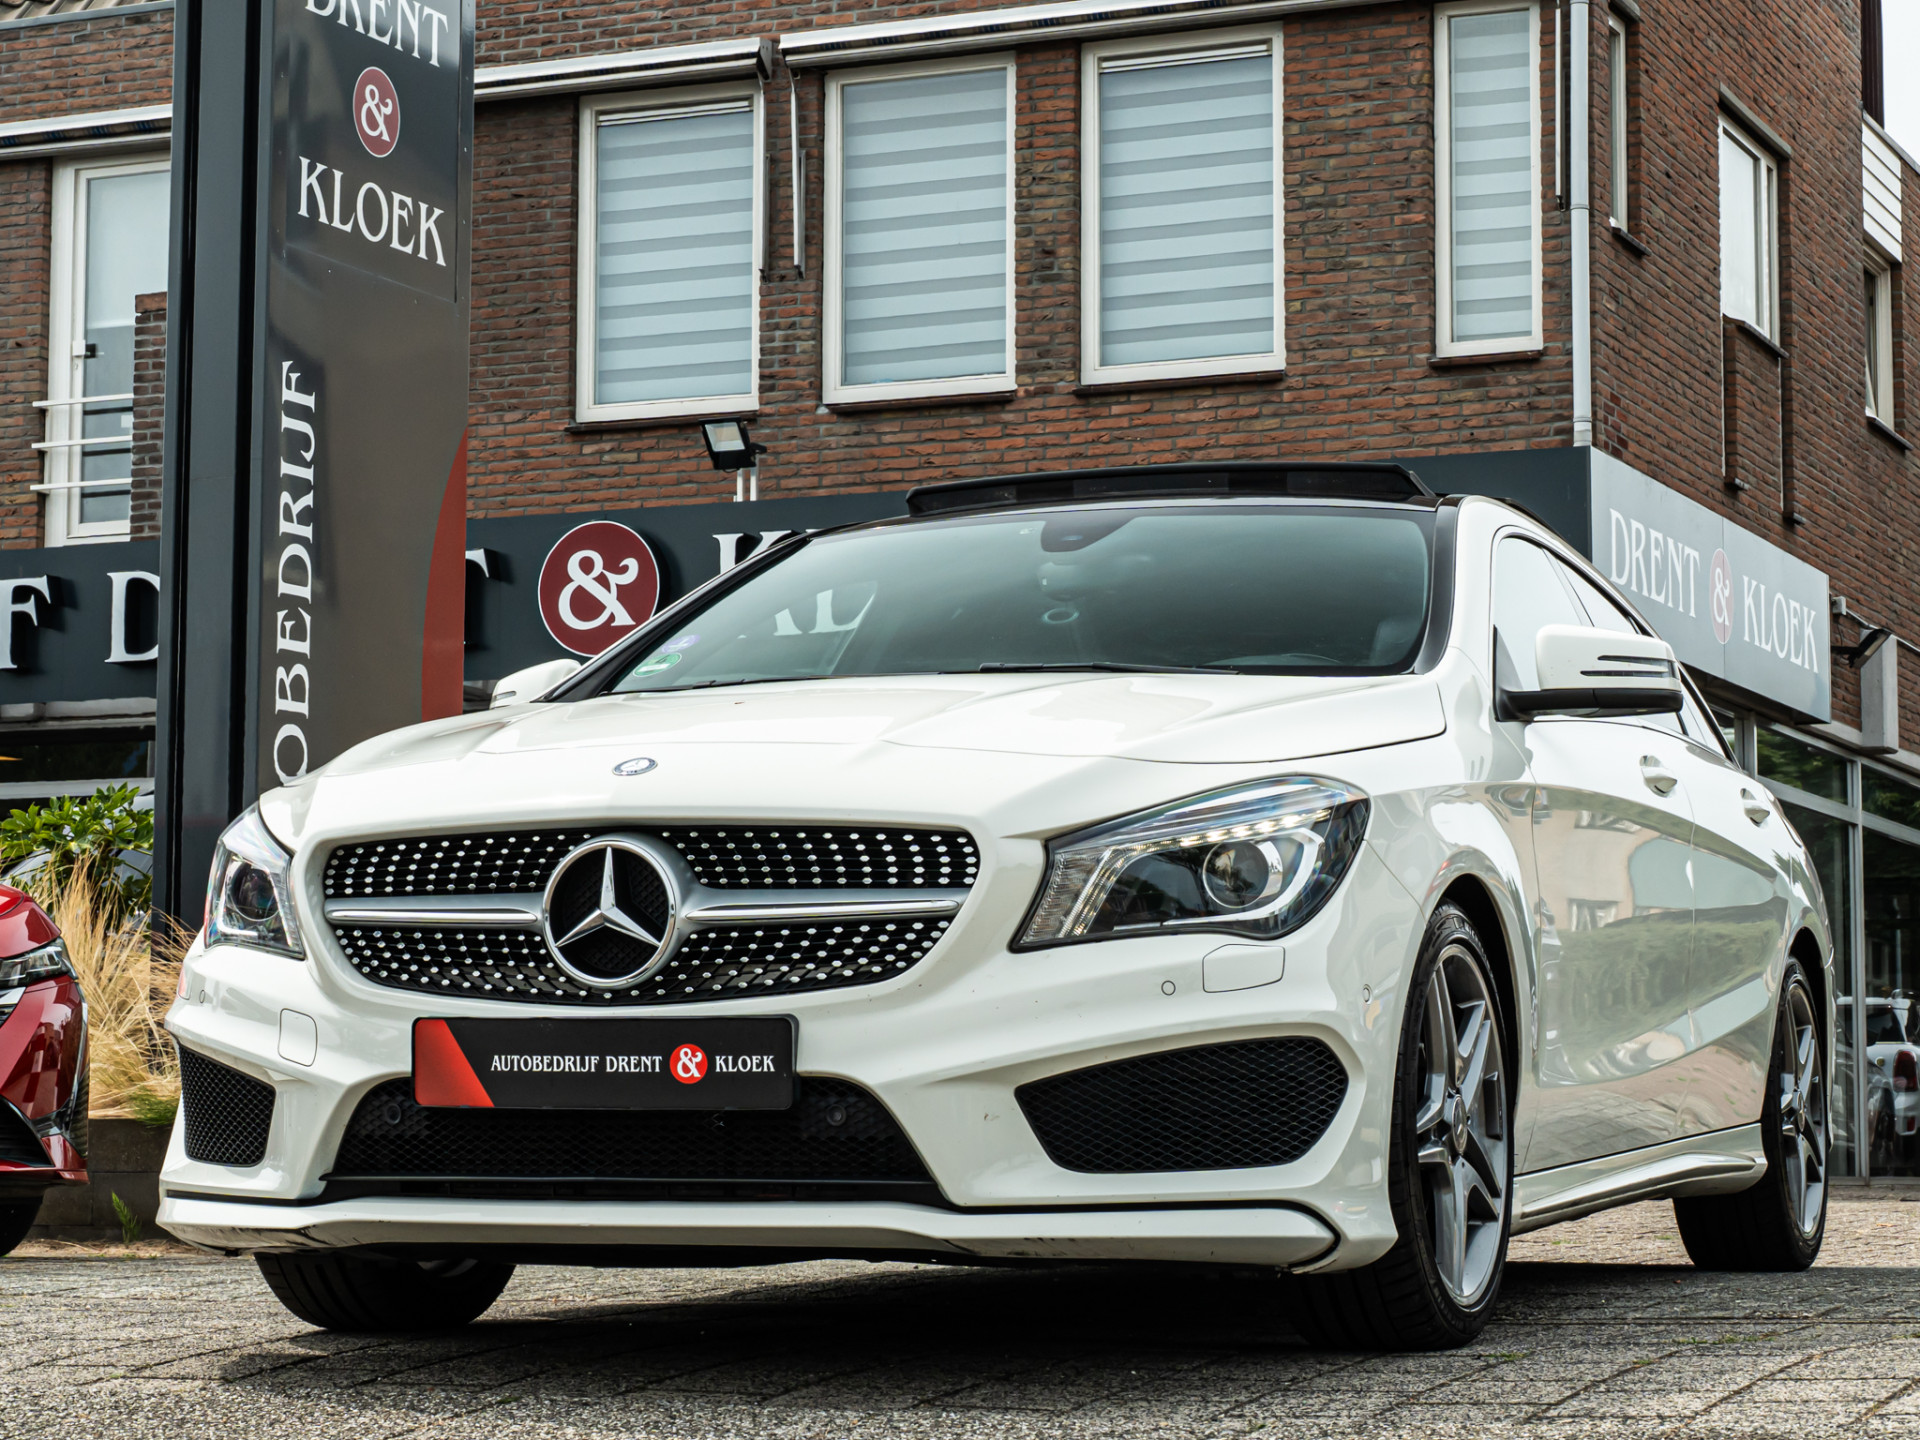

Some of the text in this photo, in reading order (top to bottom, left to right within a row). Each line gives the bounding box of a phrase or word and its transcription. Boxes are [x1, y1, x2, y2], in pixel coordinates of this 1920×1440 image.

[305, 0, 449, 68] ENT
[360, 84, 393, 142] &
[297, 156, 447, 267] KLOEK
[557, 549, 640, 631] &
[1609, 507, 1819, 674] DRENT & KLOEK
[490, 1047, 776, 1078] AUTOBEDRIJF DRENT & KLOEK
